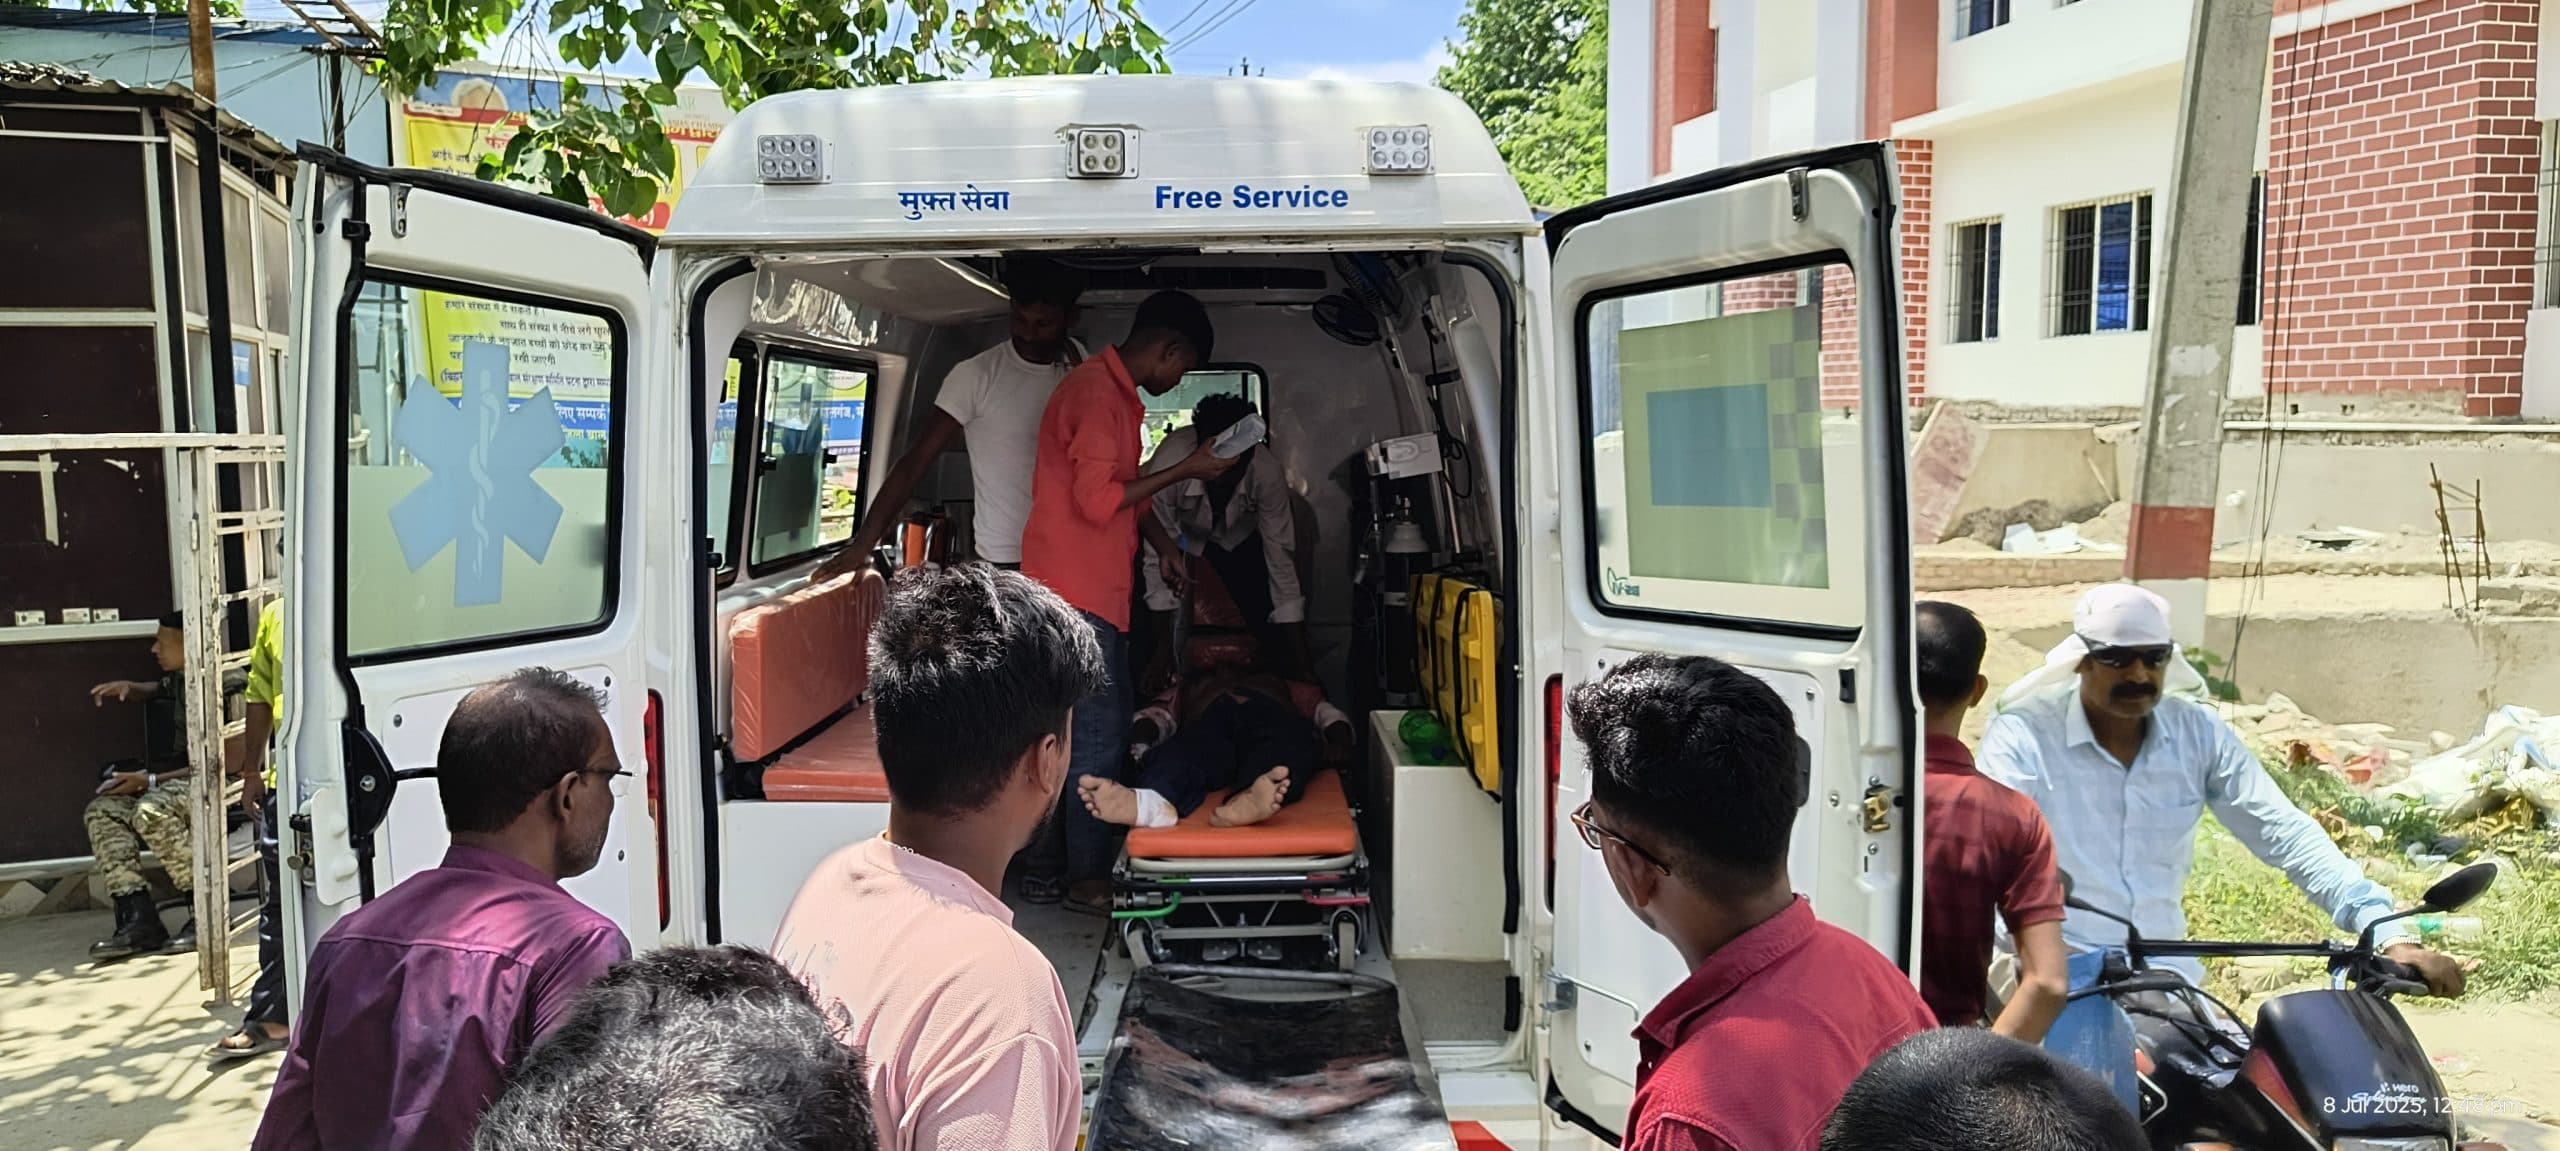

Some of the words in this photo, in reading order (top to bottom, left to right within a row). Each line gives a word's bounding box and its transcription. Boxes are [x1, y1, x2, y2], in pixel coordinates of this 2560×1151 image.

[960, 183, 1010, 212] सेवा
[1156, 186, 1222, 209] Free
[1233, 184, 1349, 208] Service
